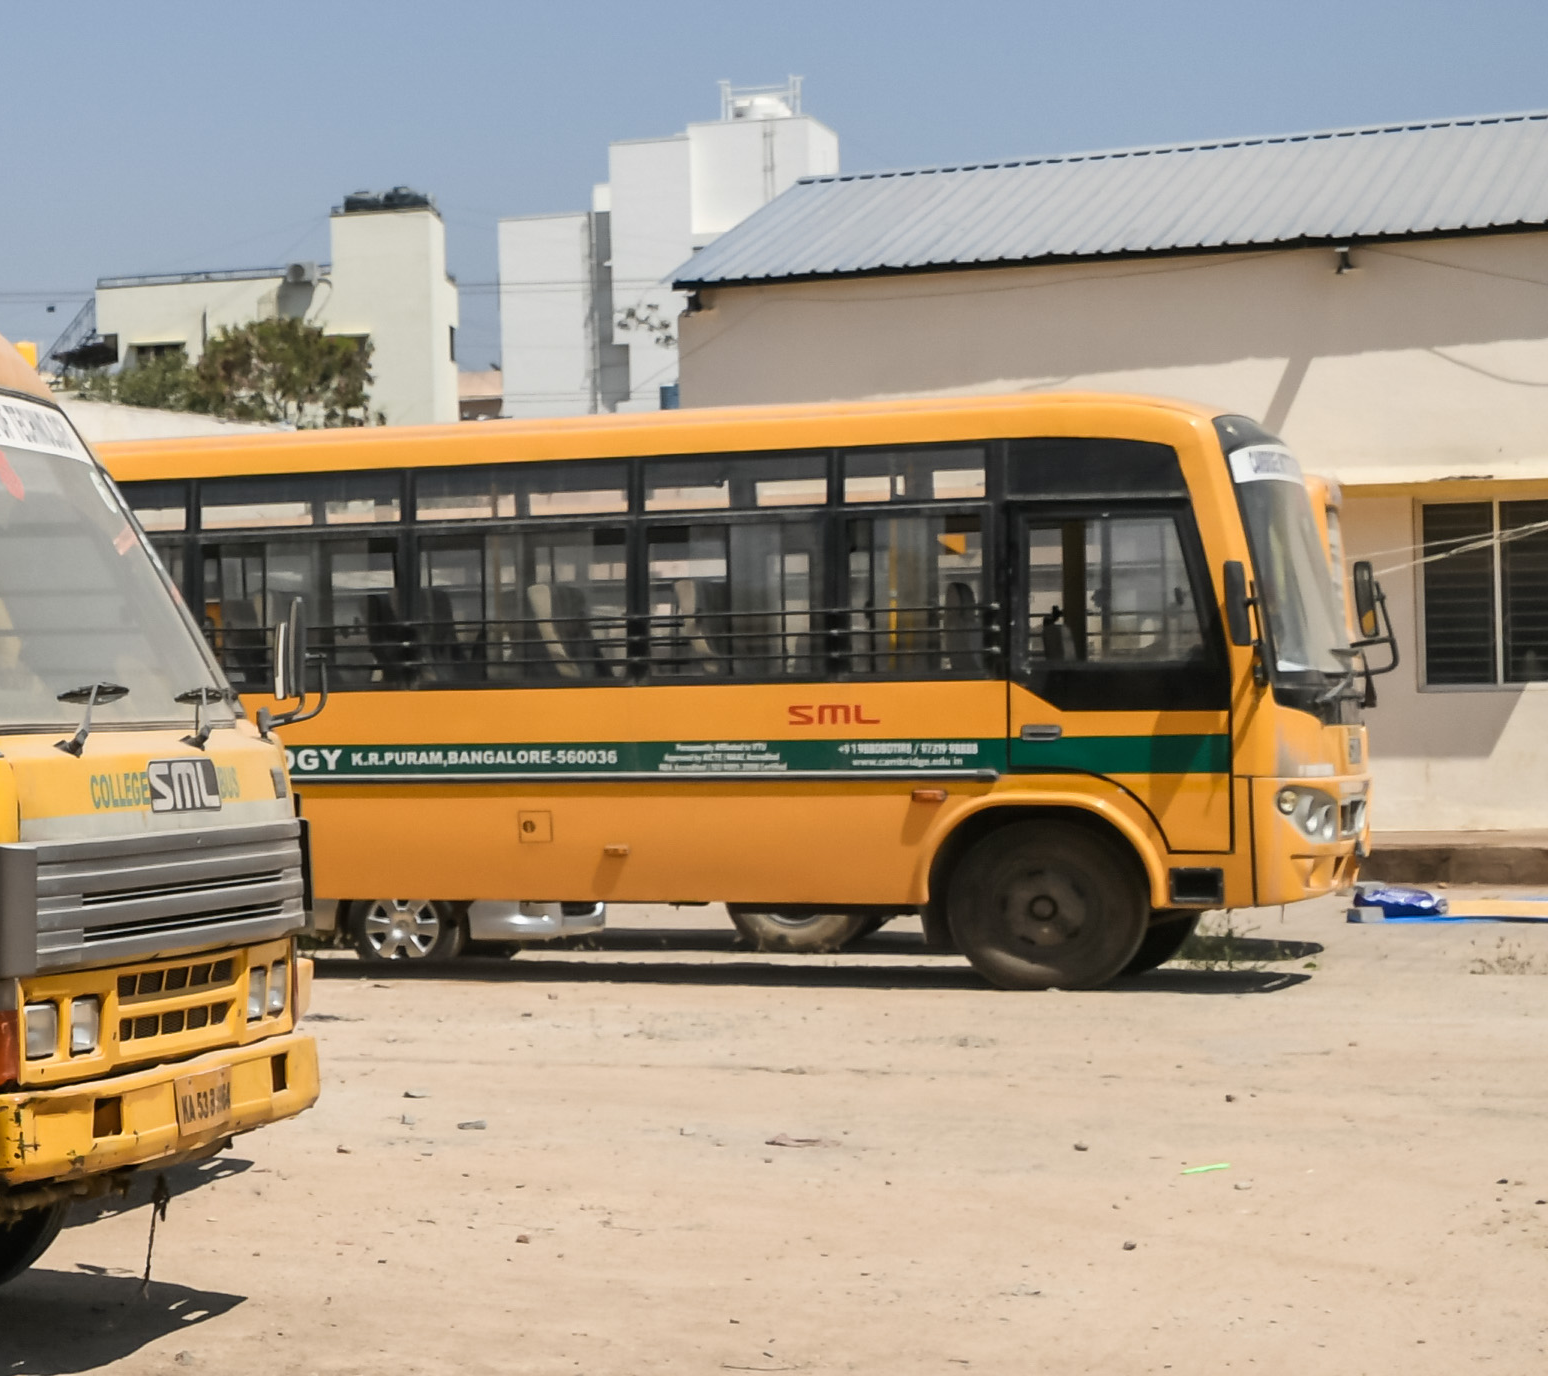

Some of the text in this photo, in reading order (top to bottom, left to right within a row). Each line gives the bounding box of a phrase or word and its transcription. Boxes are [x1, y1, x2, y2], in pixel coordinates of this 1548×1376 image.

[788, 704, 881, 726] SML
[90, 771, 150, 809] COLLEGE
[149, 762, 220, 811] SML
